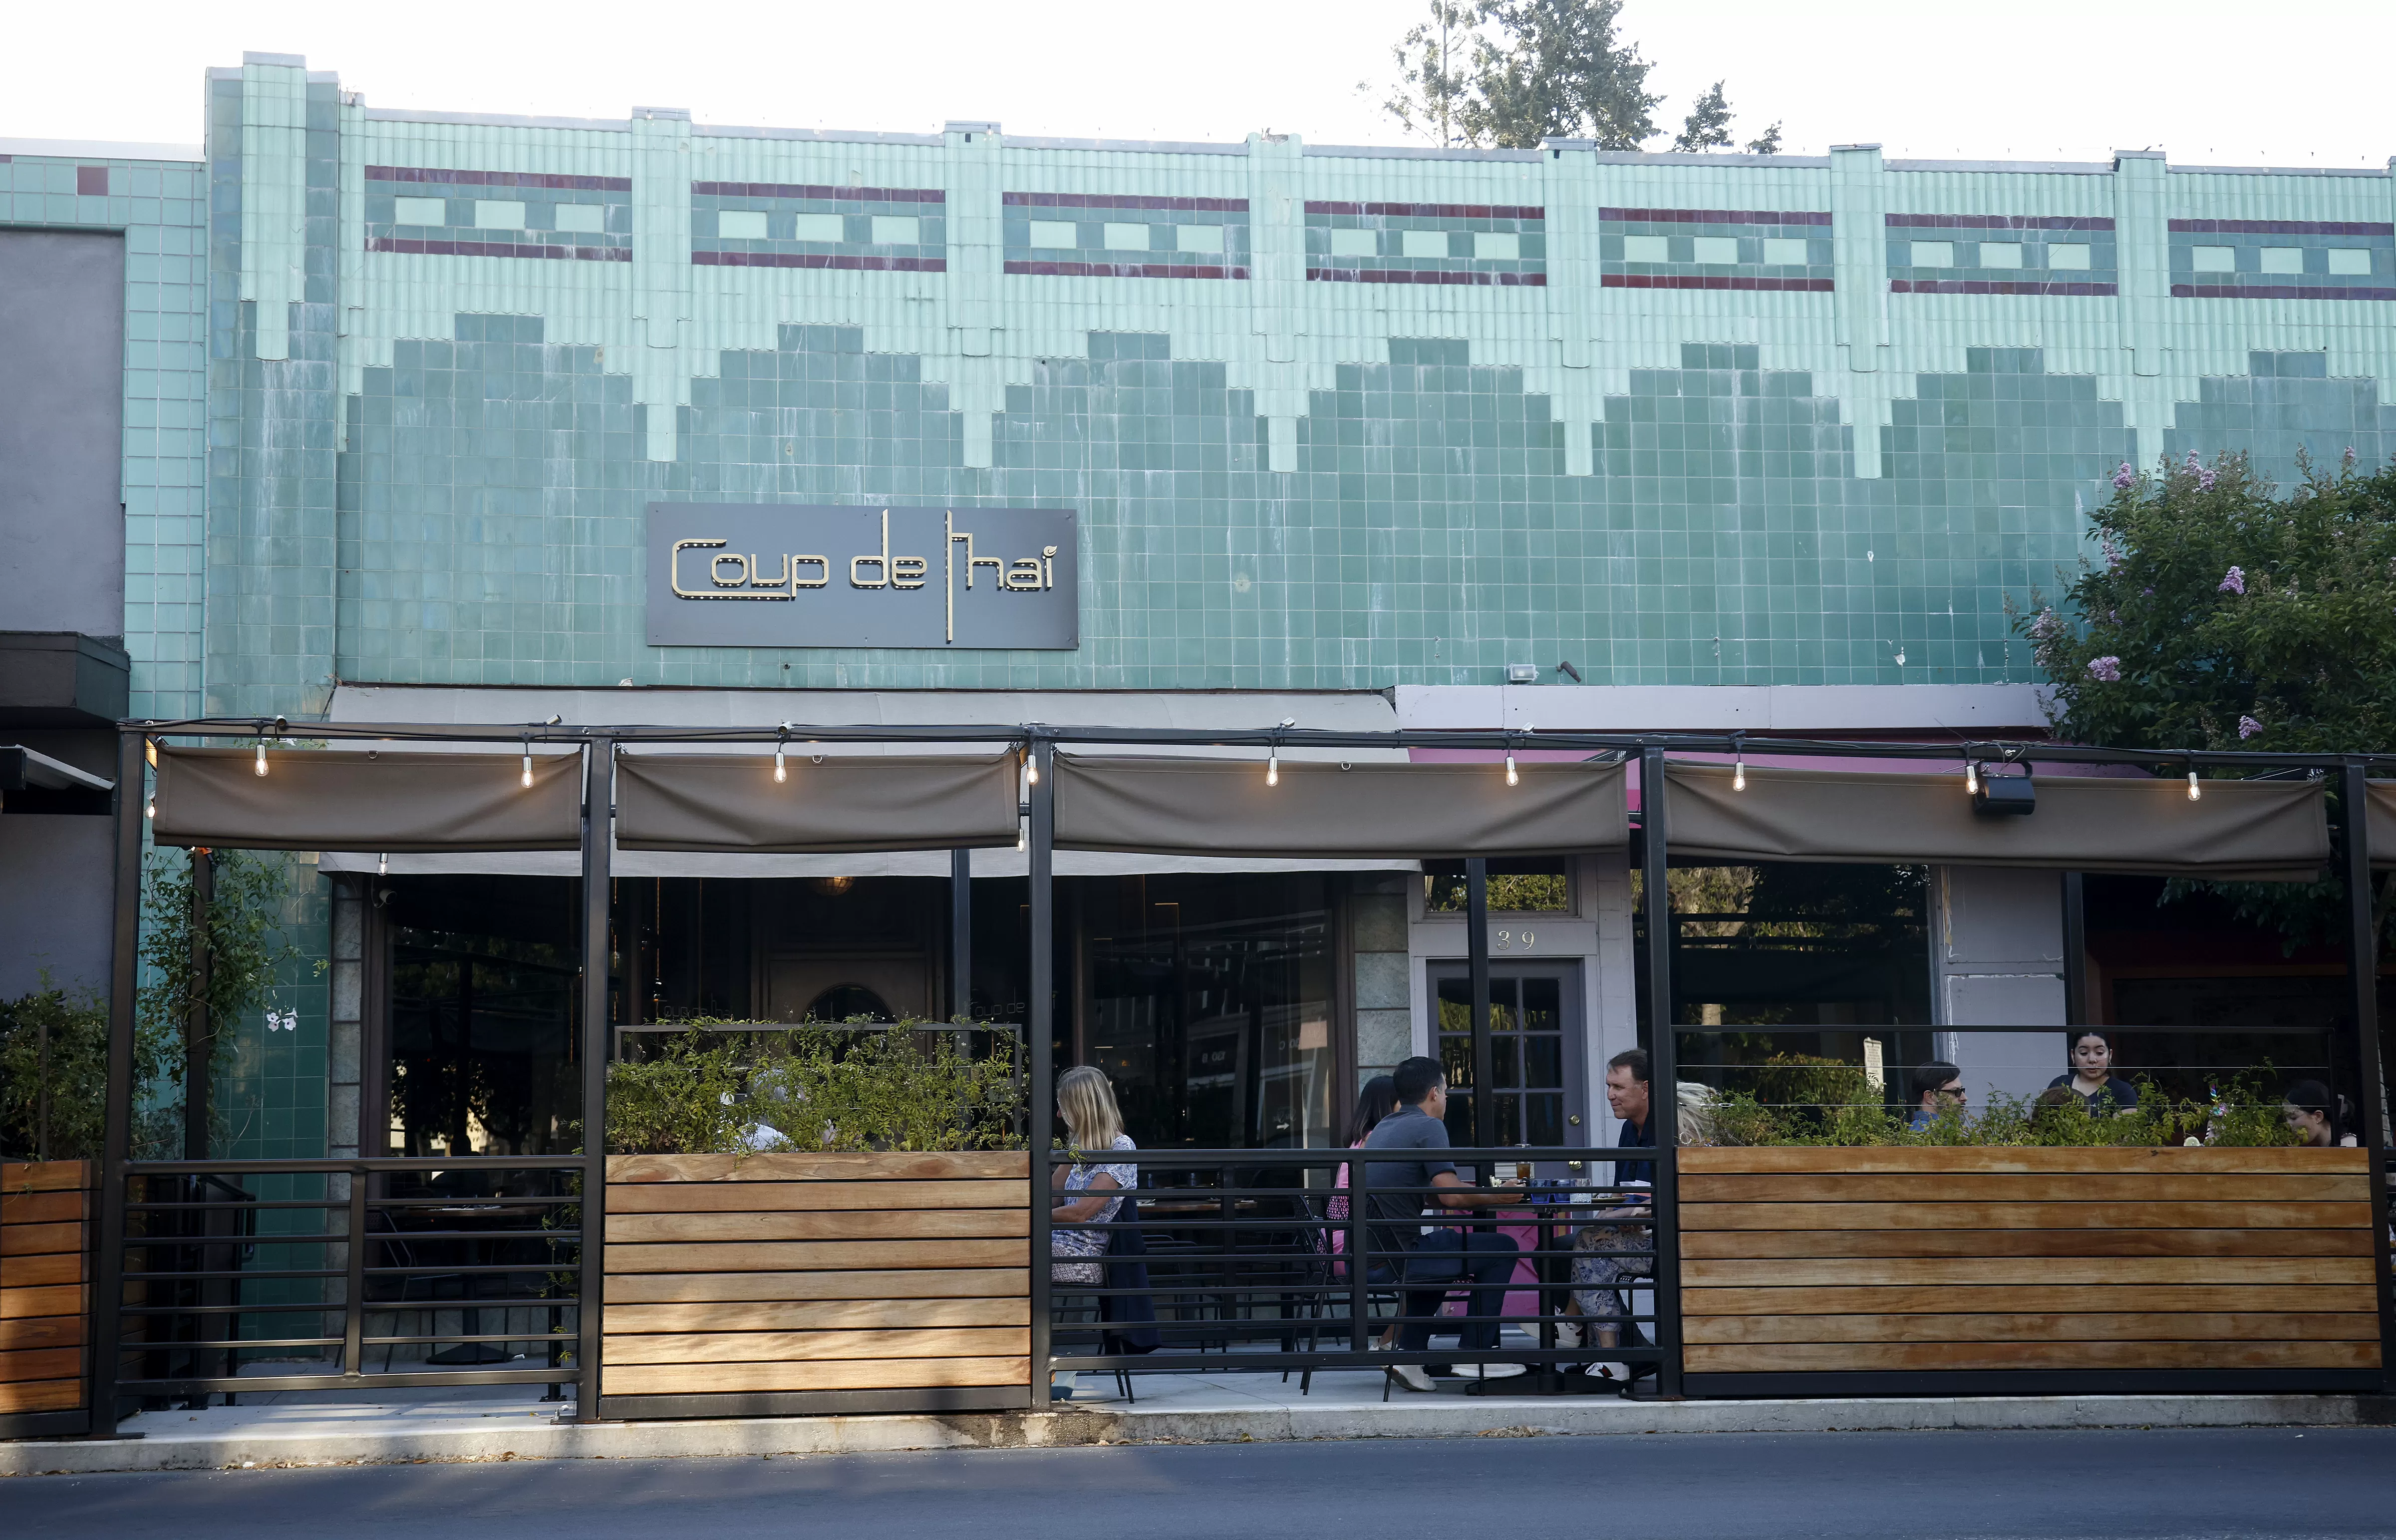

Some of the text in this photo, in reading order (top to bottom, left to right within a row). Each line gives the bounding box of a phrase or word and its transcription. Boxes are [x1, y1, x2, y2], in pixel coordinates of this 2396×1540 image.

[671, 508, 1058, 643] Coup de Thai
[1006, 985, 1025, 1014] de
